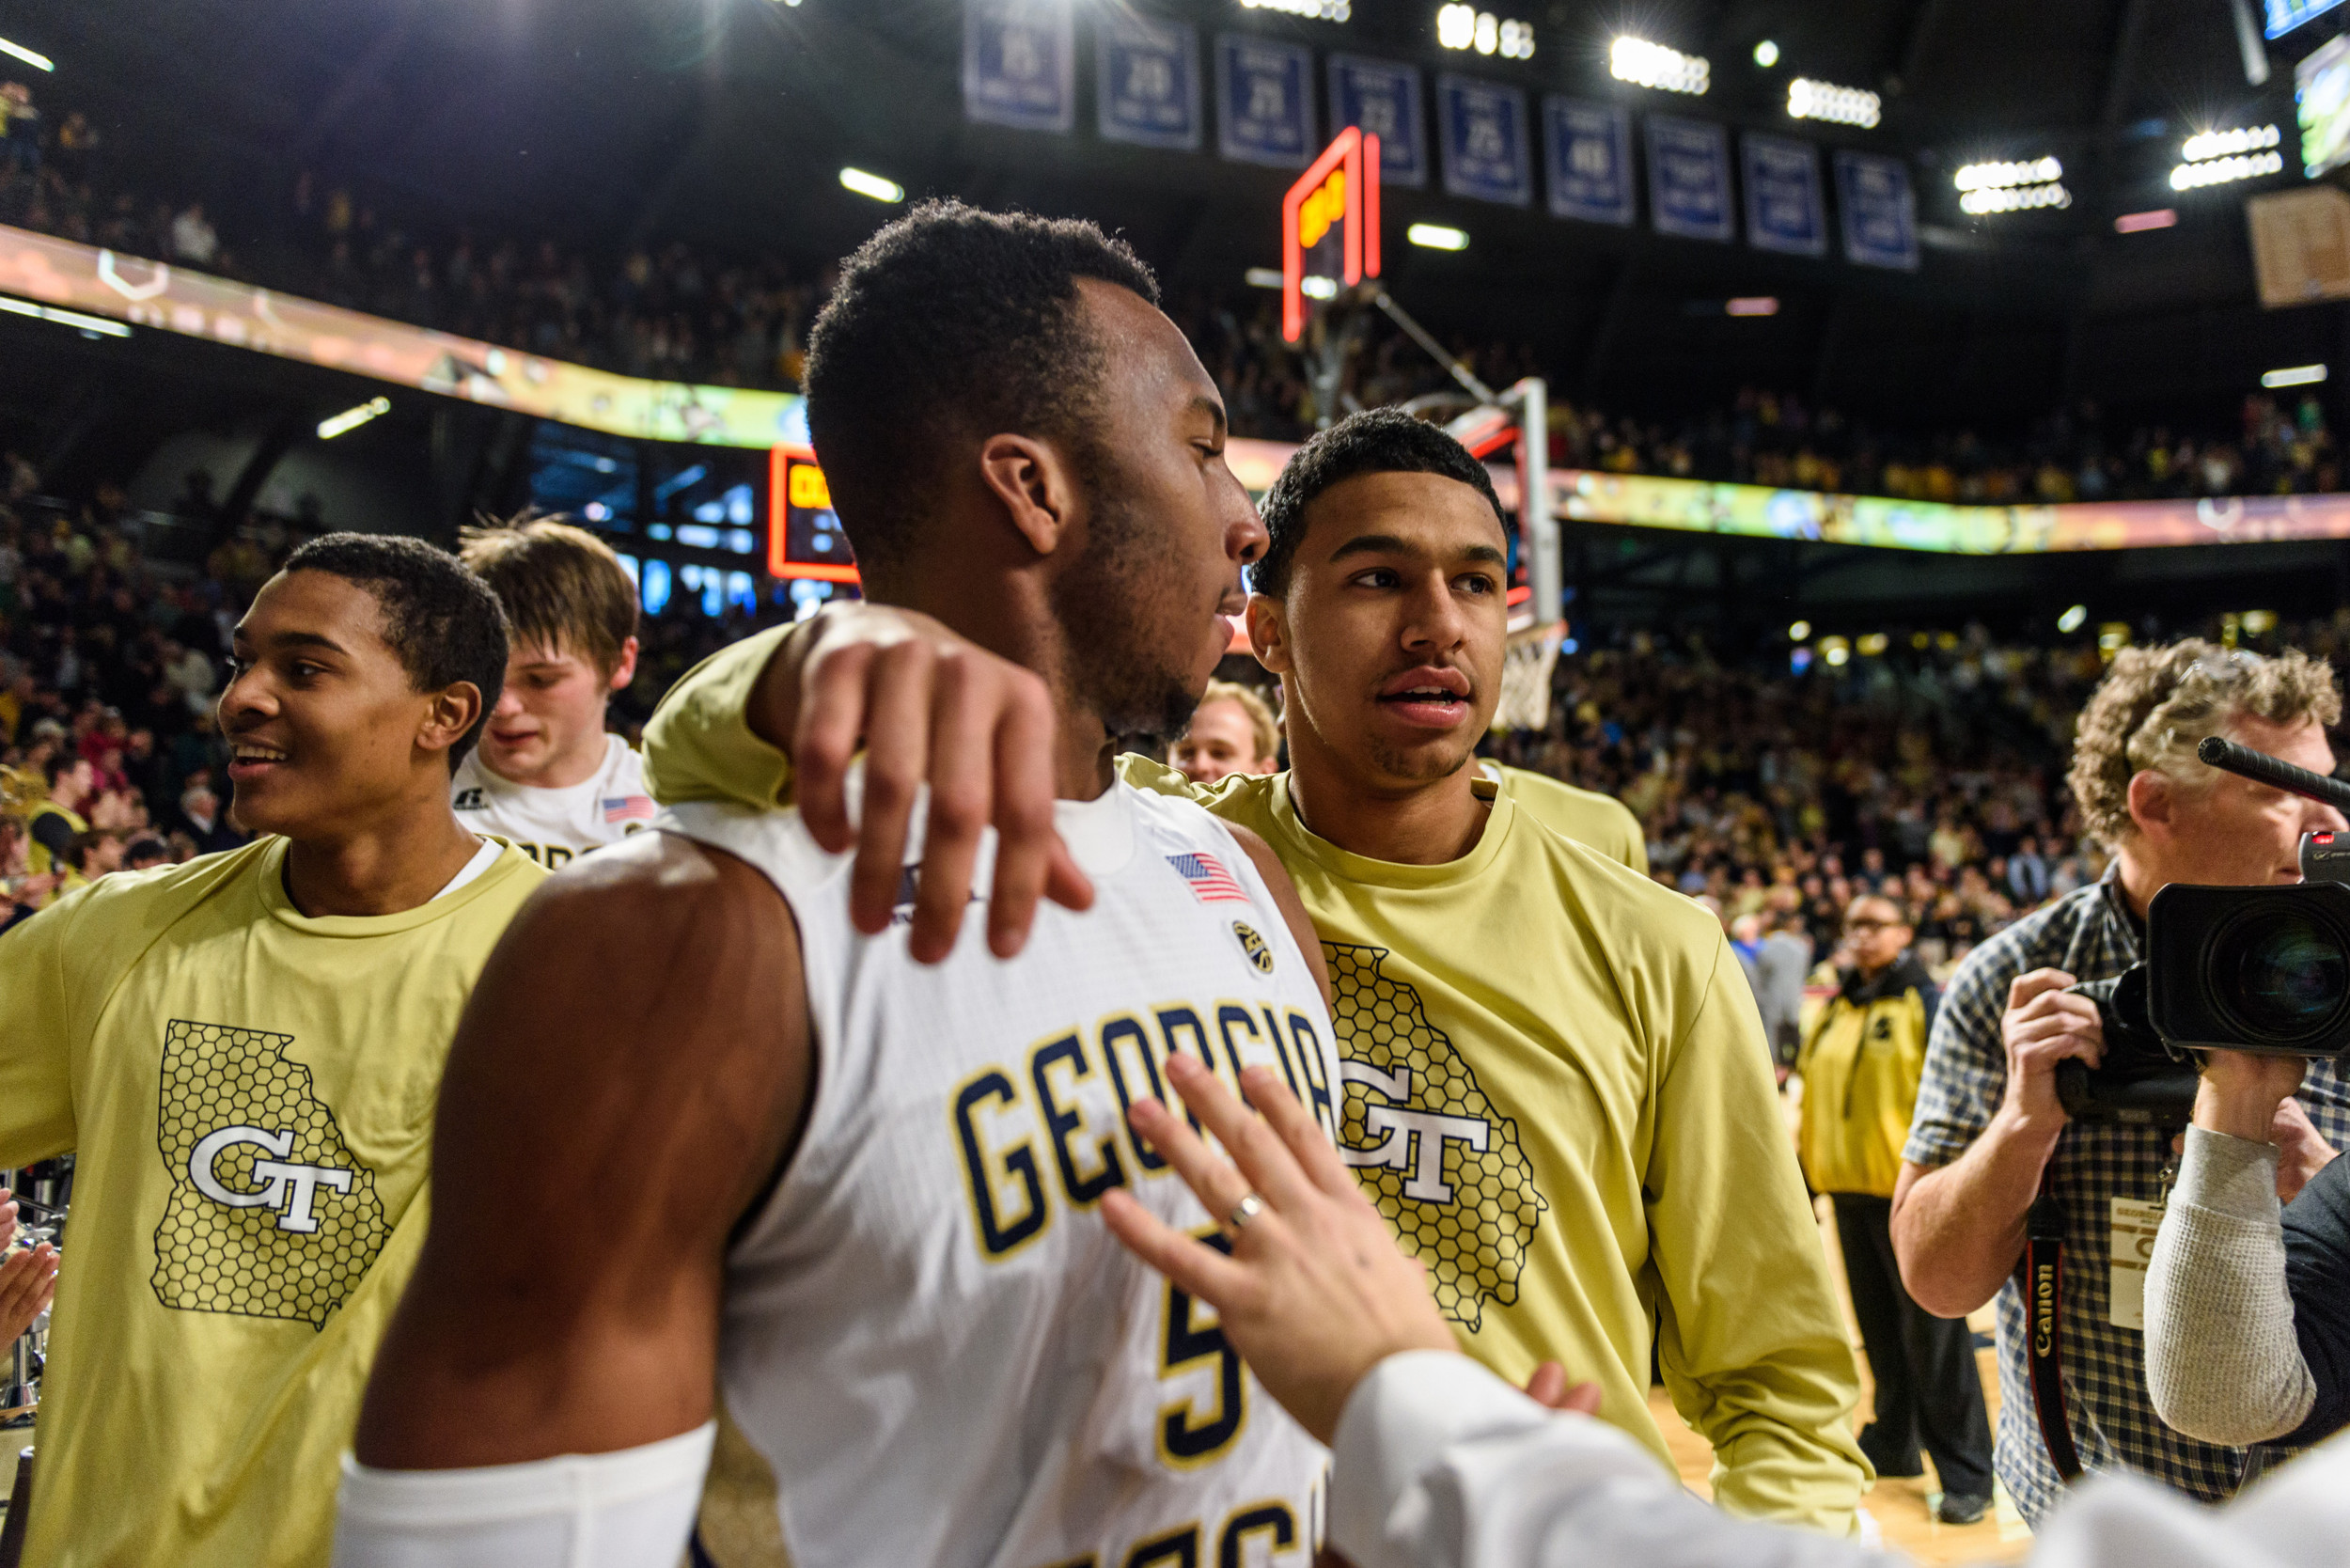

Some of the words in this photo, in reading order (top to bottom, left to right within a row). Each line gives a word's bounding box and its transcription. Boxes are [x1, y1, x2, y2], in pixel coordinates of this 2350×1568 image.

[189, 1124, 355, 1234] GT
[1339, 1058, 1491, 1205] GT
[1154, 1219, 1249, 1473] 5
[2035, 1264, 2054, 1358] Canon
